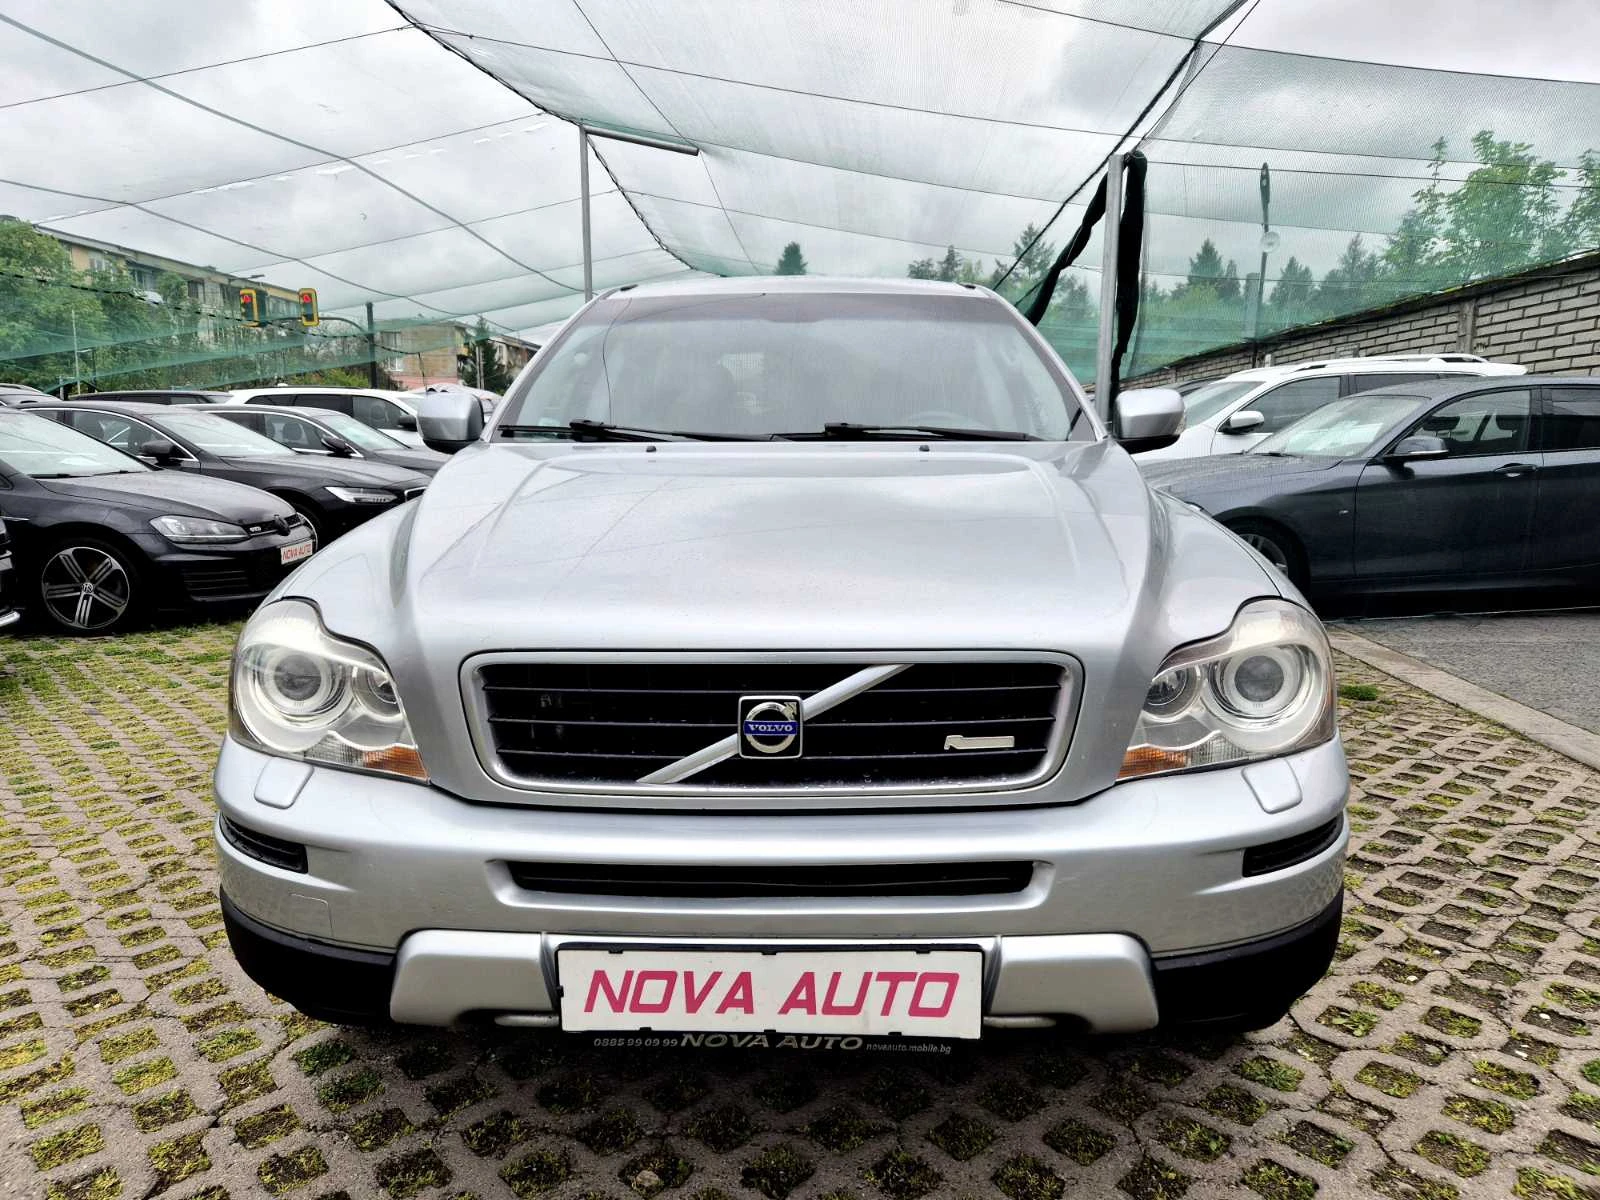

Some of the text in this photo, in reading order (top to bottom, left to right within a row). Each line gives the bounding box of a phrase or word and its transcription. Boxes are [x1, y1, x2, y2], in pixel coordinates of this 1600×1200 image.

[748, 723, 794, 732] VOLVO
[583, 969, 960, 1018] NOVA AUTO
[593, 1038, 625, 1047] 0885
[680, 1033, 770, 1048] NOVA
[775, 1035, 864, 1050] AUTO
